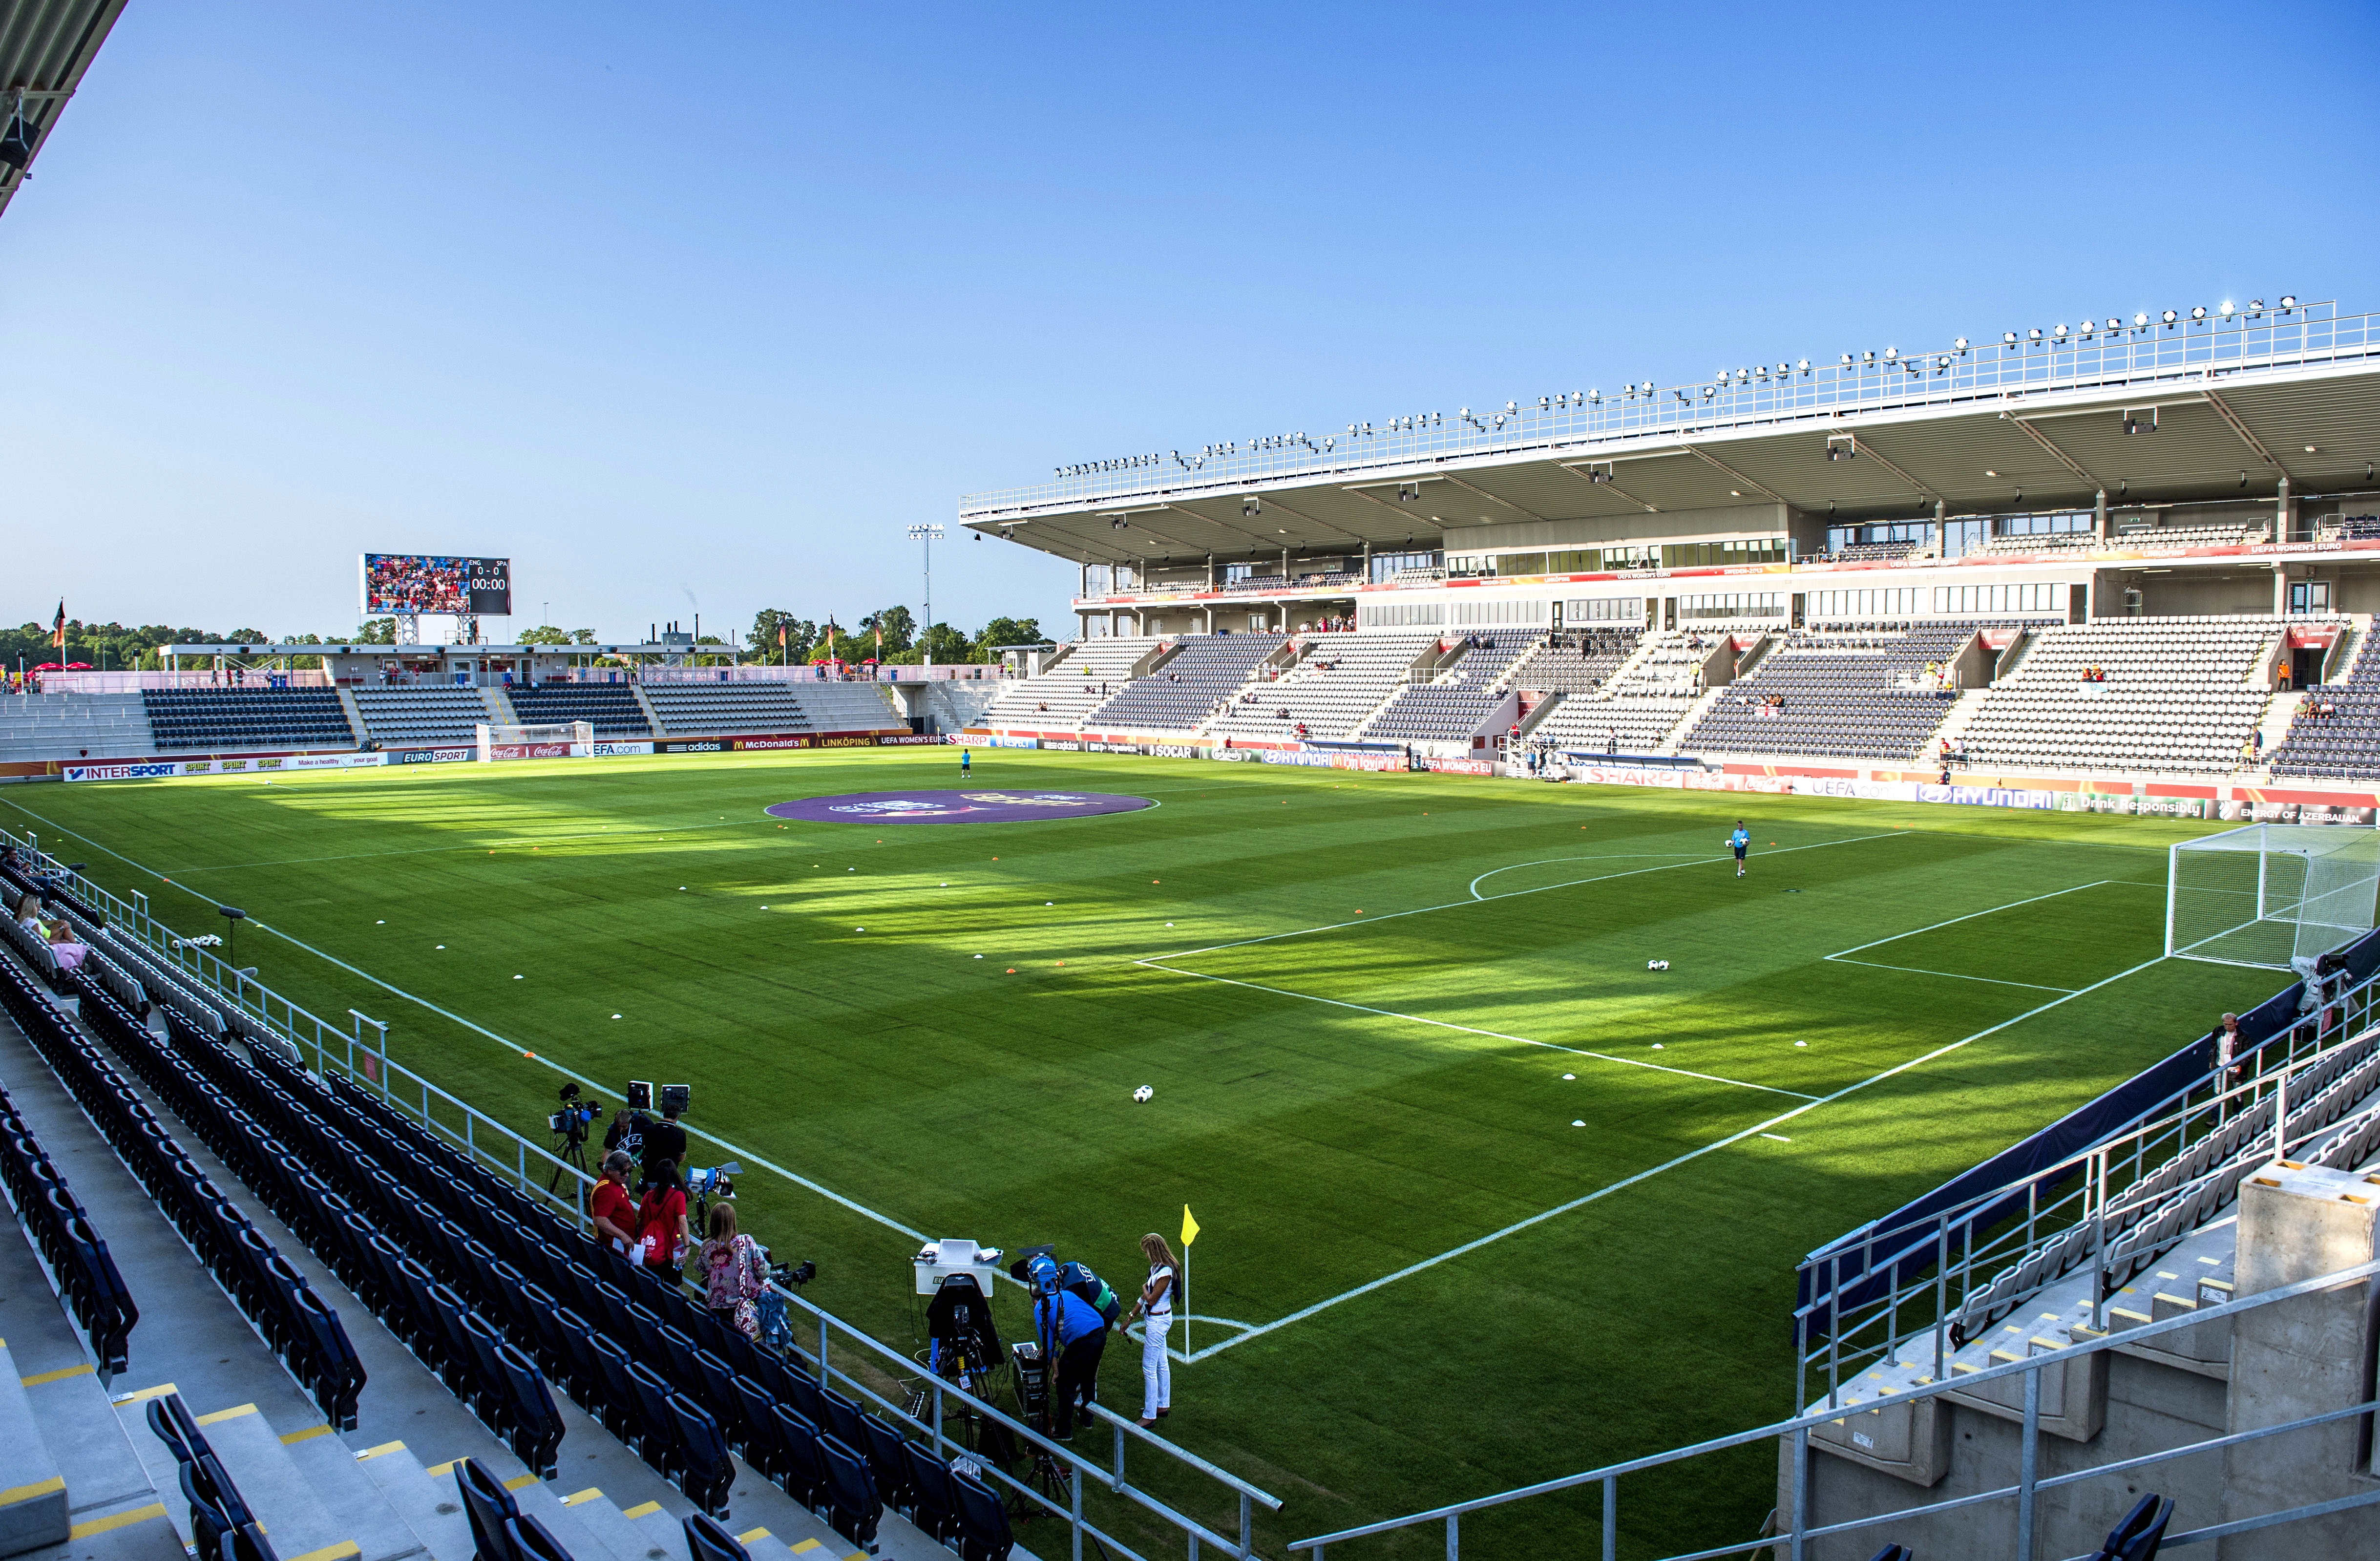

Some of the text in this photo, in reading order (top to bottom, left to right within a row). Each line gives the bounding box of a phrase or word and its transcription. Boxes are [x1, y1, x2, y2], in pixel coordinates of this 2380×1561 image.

[2143, 548, 2186, 557] LINKÖPING
[478, 567, 484, 575] 0
[494, 567, 499, 575] 0
[472, 578, 505, 590] 00:00
[745, 739, 799, 749] McDonald's
[822, 737, 870, 747] LINKÖPING
[949, 734, 987, 745] SHARP
[1004, 738, 1029, 748] RESPECT
[1057, 740, 1078, 751] adidas
[534, 745, 564, 757] Coca-Cola
[584, 744, 640, 755] UEFA.com
[688, 742, 721, 751] adidas
[1156, 744, 1192, 759] SOCAR
[1211, 747, 1243, 762] Carlsberg
[1282, 751, 1332, 766] HYUNDAI
[185, 762, 211, 771] SPORT
[222, 760, 247, 769] SPORT
[258, 759, 282, 767] SPORT
[1344, 755, 1358, 767] i'm
[1422, 759, 1441, 770] UEFA
[1442, 761, 1479, 772] WOMEN'S
[86, 764, 176, 779] INTERSPORT
[1590, 768, 1675, 786] SHARP
[1690, 774, 1726, 790] Coca-Cola
[1744, 776, 1782, 793] Coca-Cola
[1812, 781, 1895, 798] UEFA.com
[1953, 787, 2052, 809] HYUNDAI
[2081, 796, 2115, 809] Drink
[2119, 798, 2201, 817] Responsibly
[2240, 808, 2362, 823] ENERGY OF AZERBAIJAN.
[618, 1136, 642, 1150] UEFA
